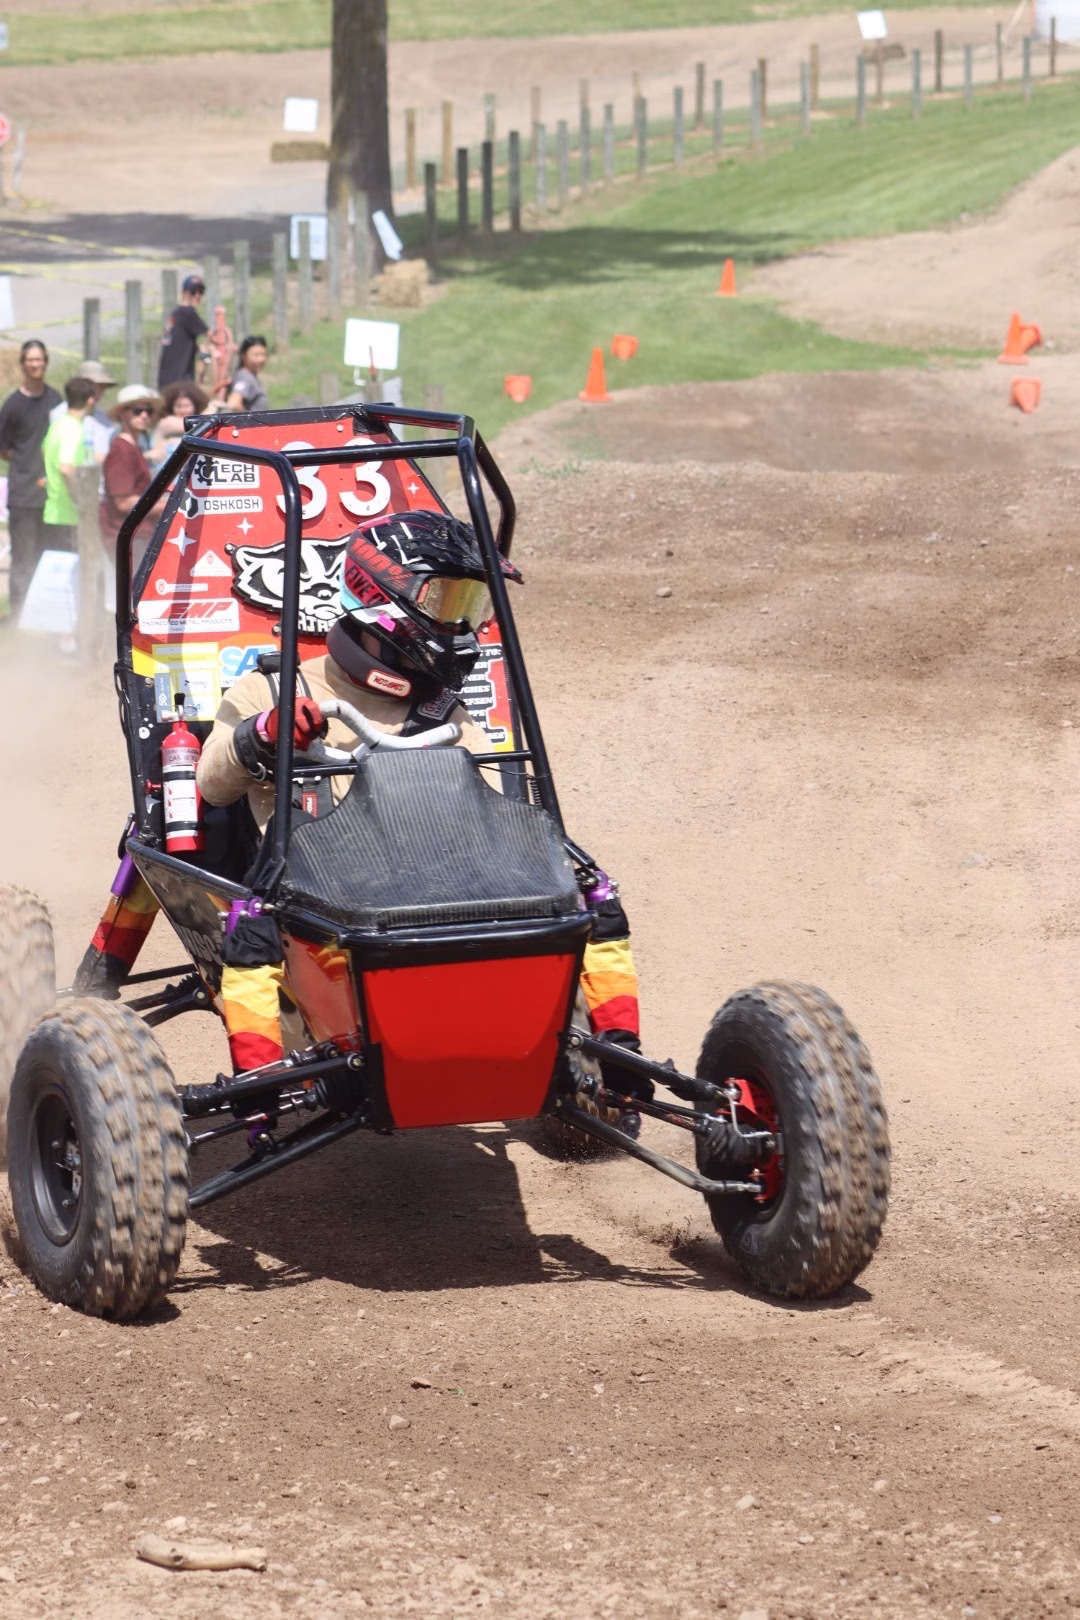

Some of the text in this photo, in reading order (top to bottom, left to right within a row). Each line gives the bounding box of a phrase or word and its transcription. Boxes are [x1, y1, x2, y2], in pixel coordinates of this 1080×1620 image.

[276, 437, 391, 520] 33
[204, 499, 259, 511] OSHKOSH
[352, 537, 413, 590] 100%
[160, 601, 233, 619] EMP
